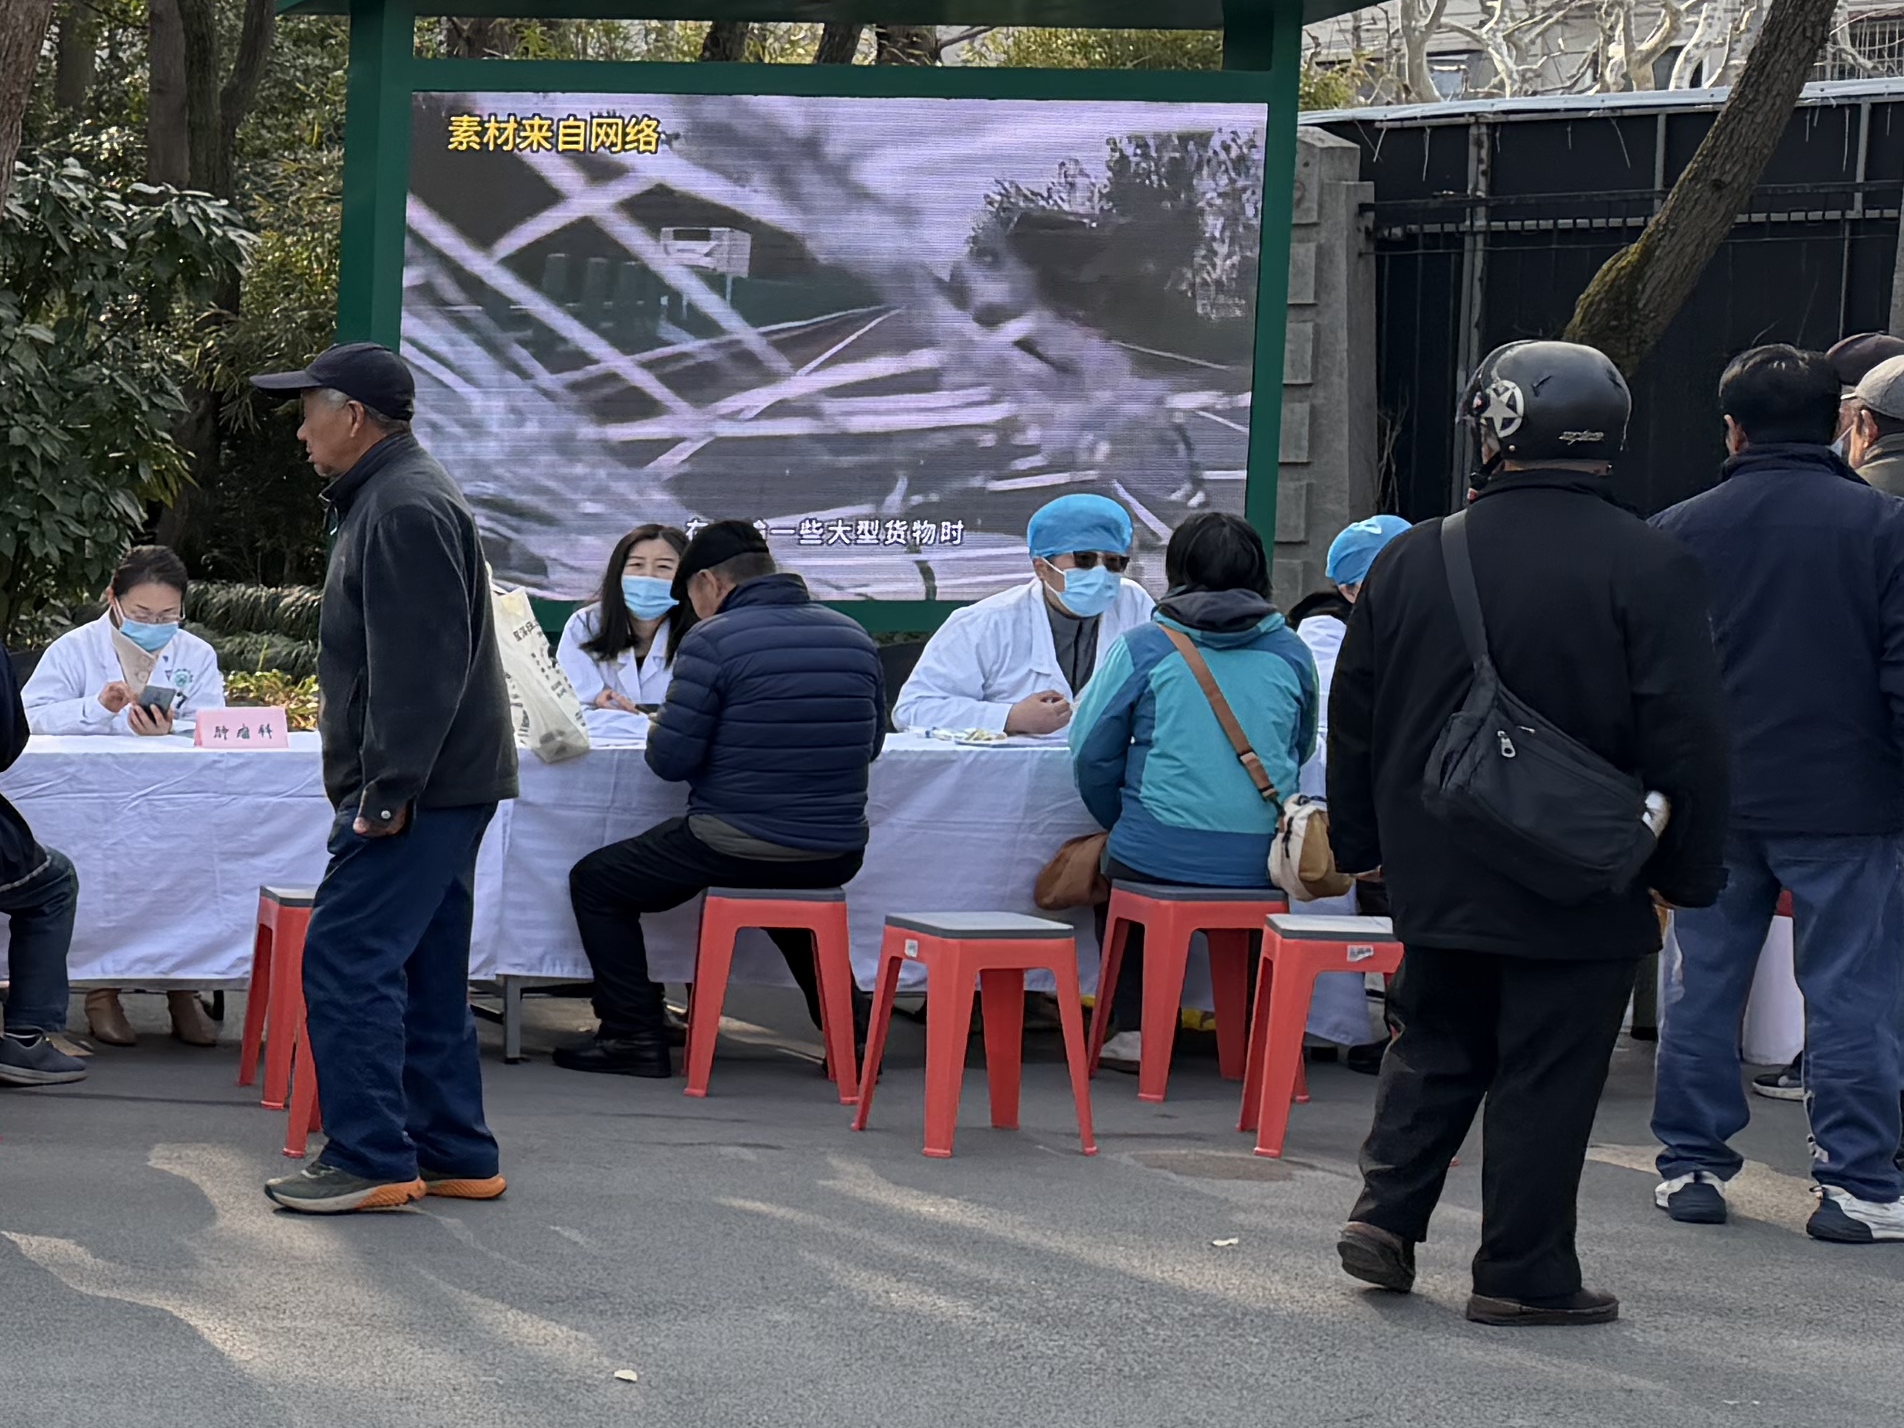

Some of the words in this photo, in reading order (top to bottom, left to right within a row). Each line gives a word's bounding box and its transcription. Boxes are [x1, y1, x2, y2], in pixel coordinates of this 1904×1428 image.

[447, 114, 659, 154] 素材来自网络
[686, 519, 965, 546] 一些大型货物时
